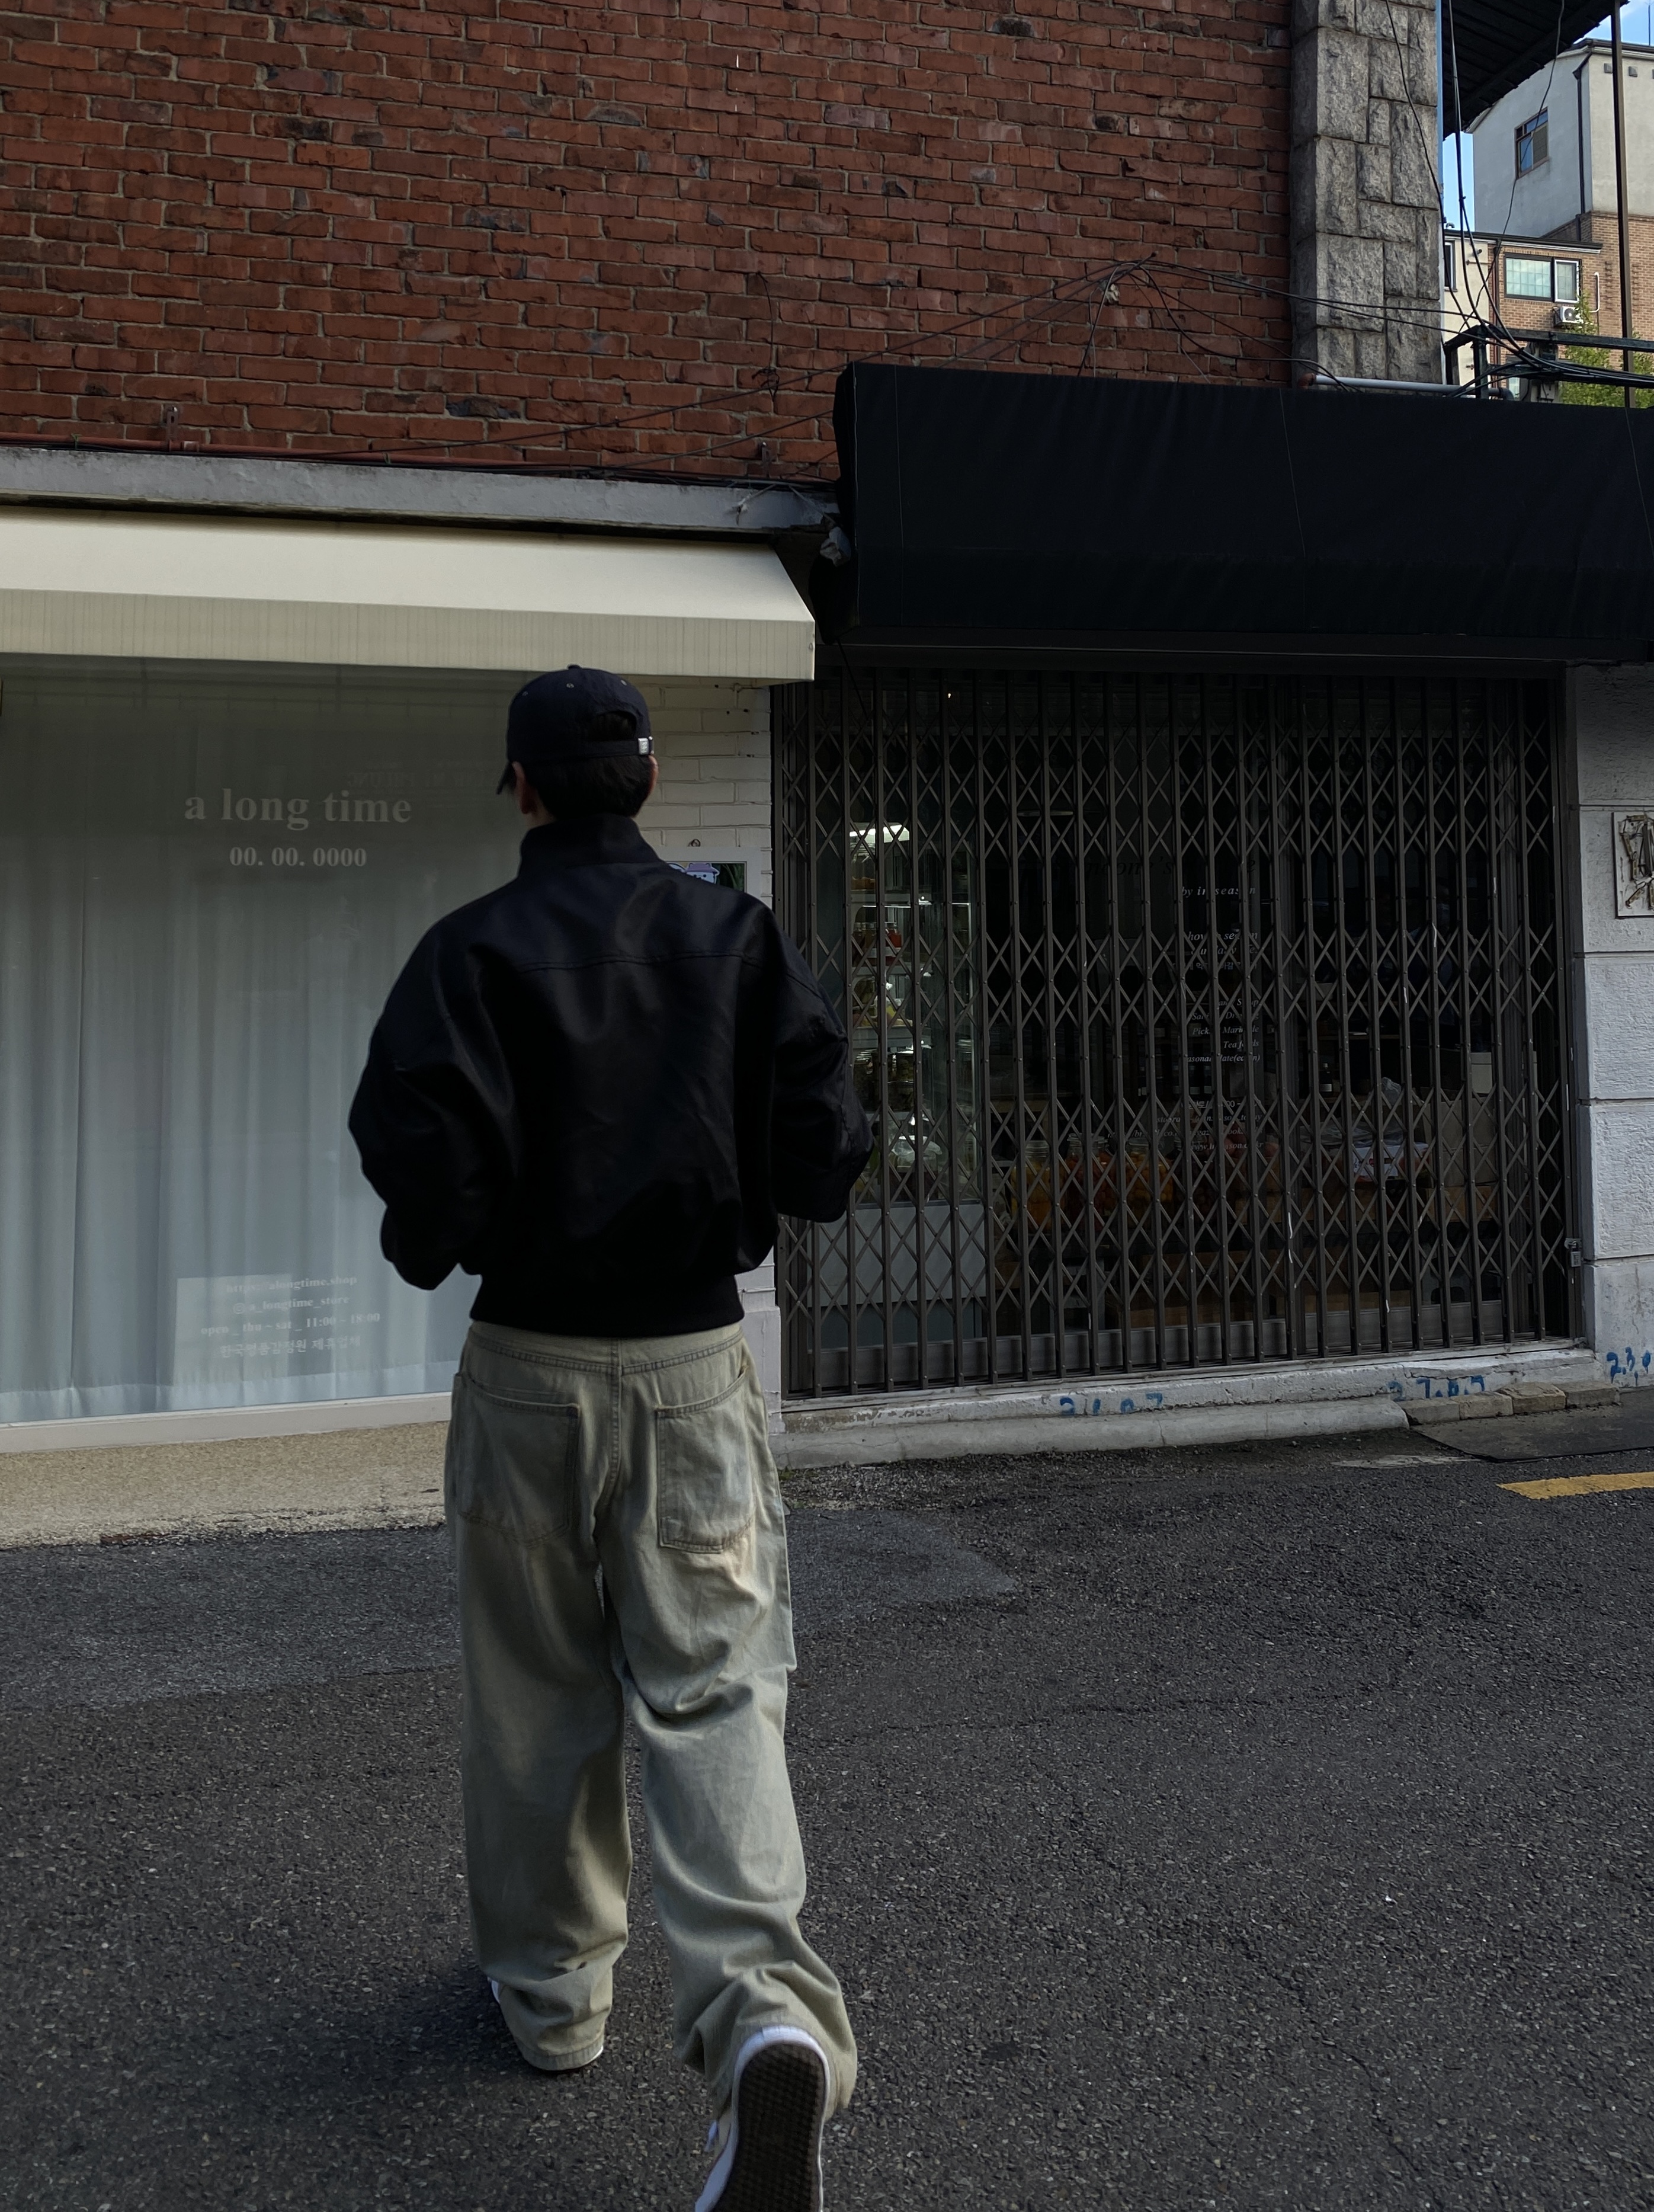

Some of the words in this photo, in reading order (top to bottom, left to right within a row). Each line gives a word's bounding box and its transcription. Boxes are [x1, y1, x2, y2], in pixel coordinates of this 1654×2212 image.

[185, 795, 206, 820] a
[221, 788, 309, 831] long
[323, 789, 412, 824] time
[229, 846, 264, 867] 00.
[271, 847, 306, 867] 00.
[313, 847, 367, 867] 0000
[1215, 887, 1256, 896] seasn
[1223, 1041, 1237, 1049] Tea
[200, 1325, 230, 1337] open
[242, 1321, 262, 1332] thu
[275, 1321, 293, 1330] sat
[306, 1316, 336, 1328] 11:00
[350, 1312, 380, 1324] 18:00
